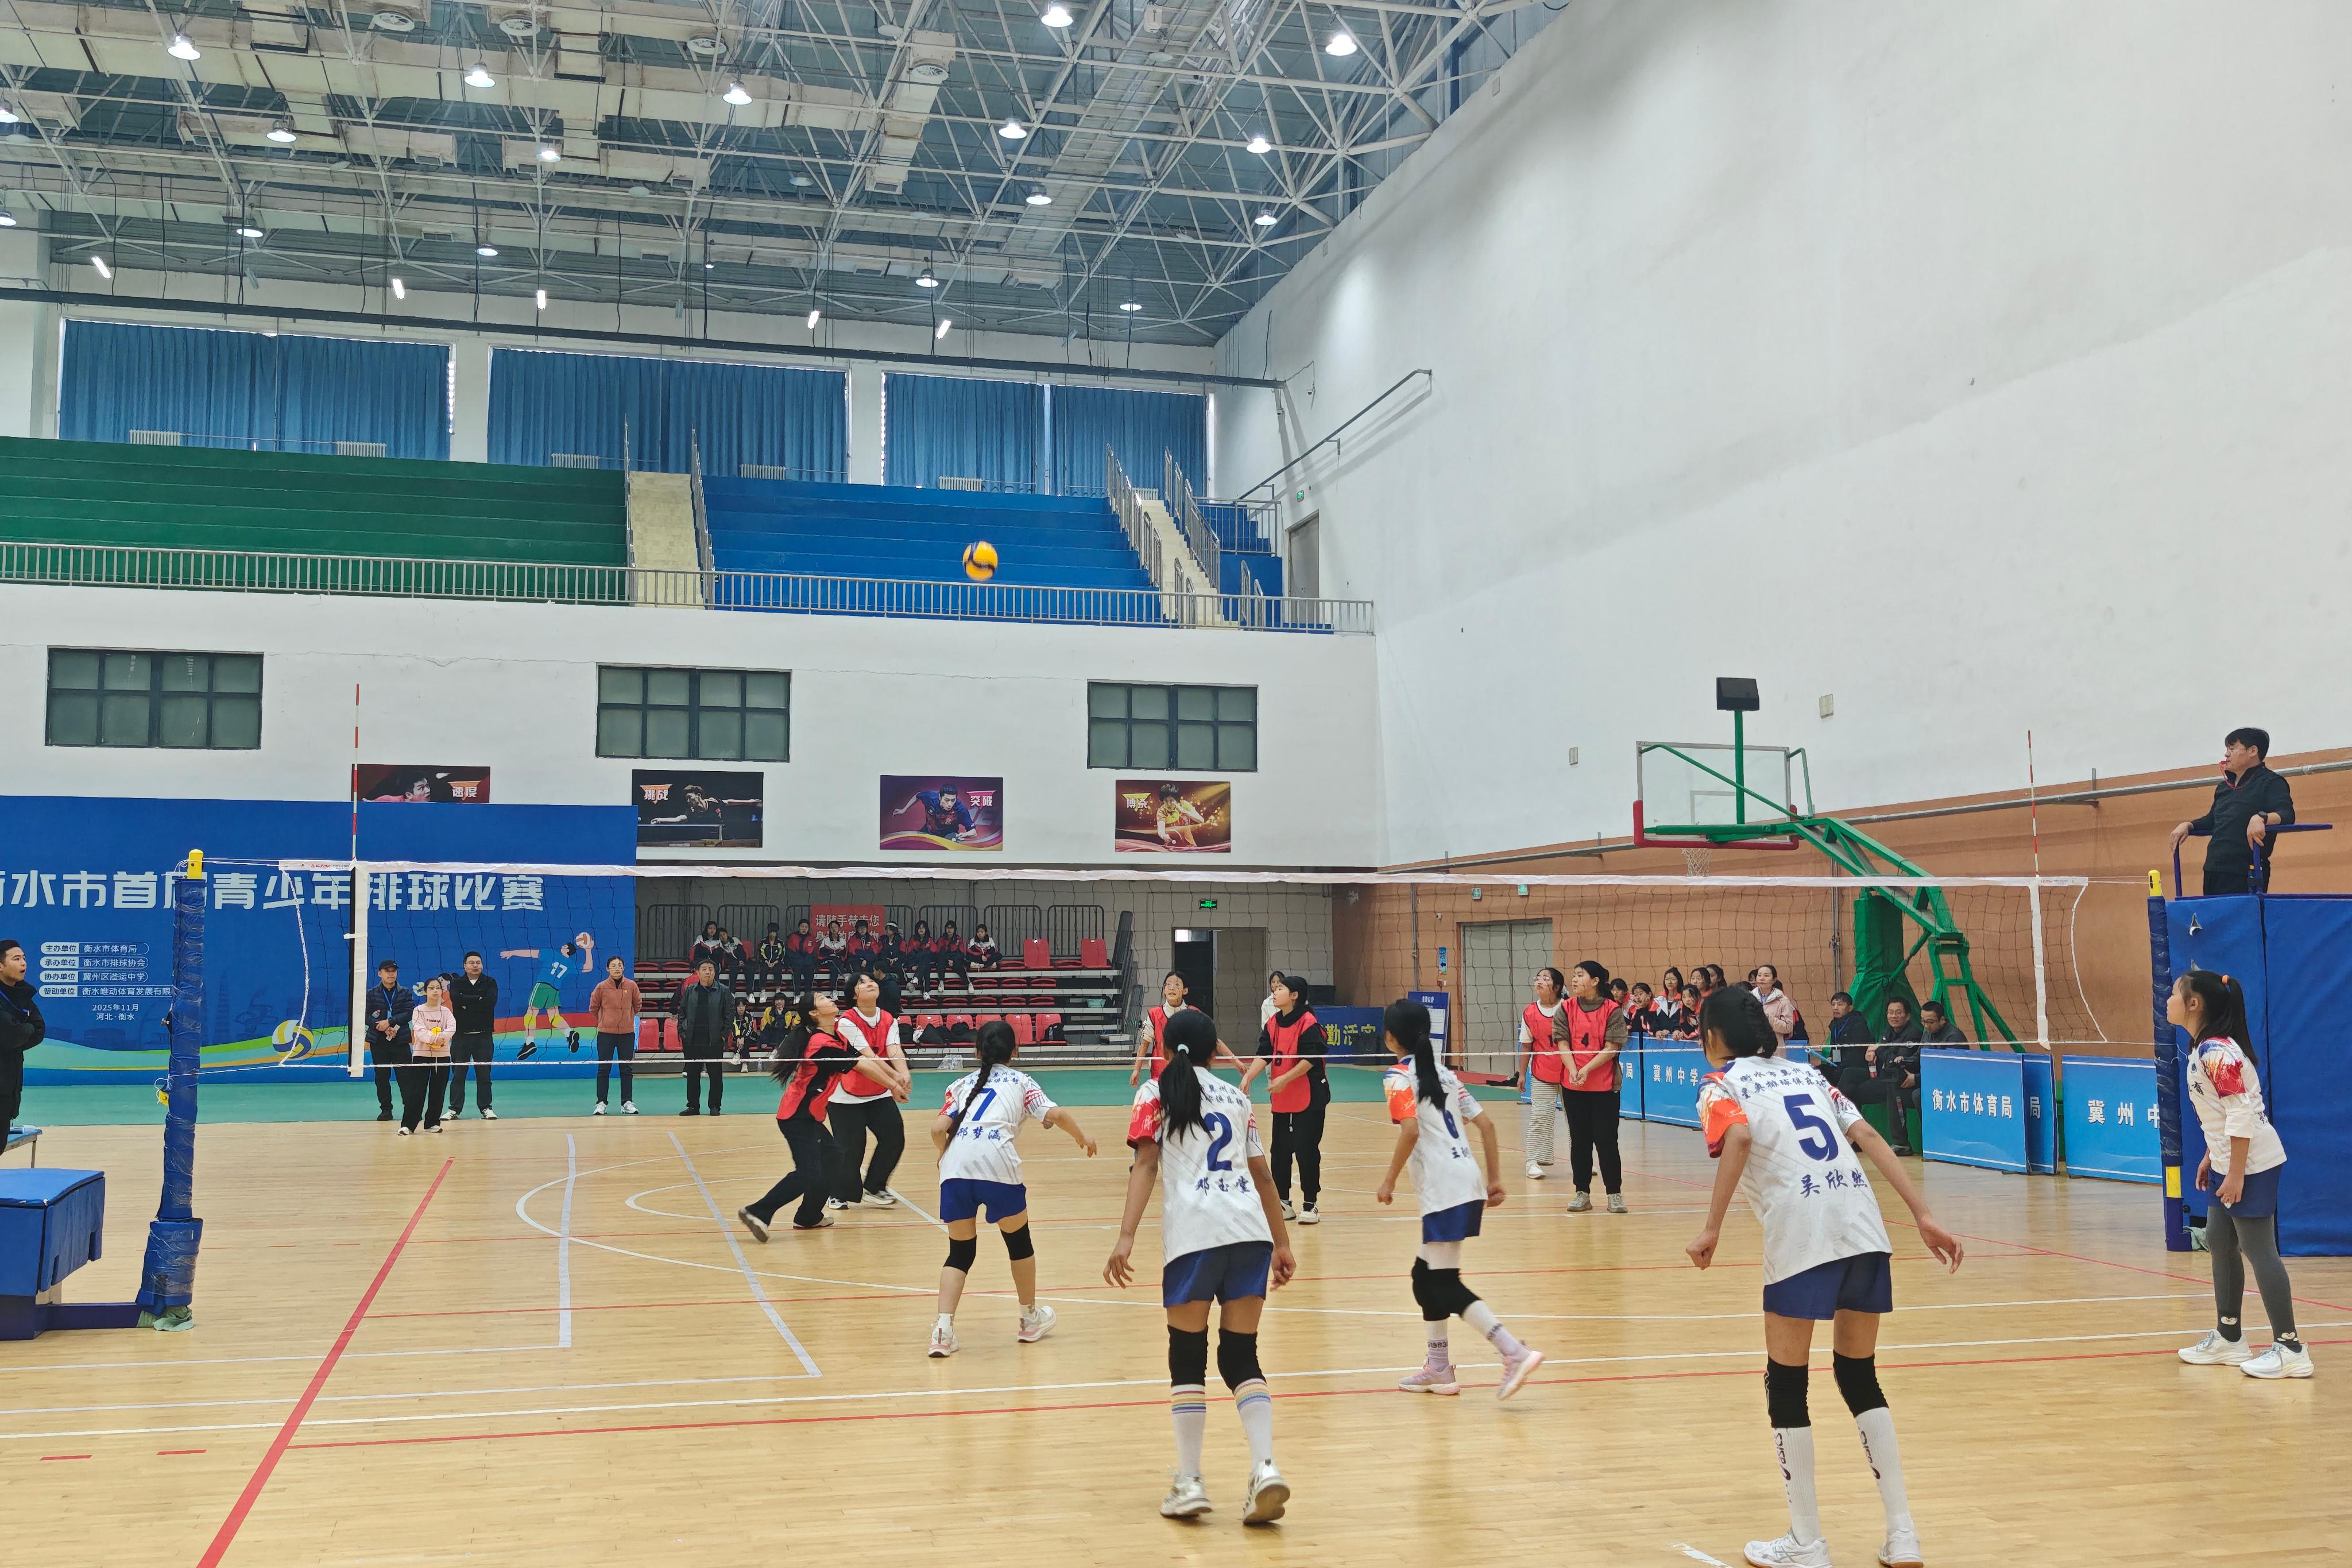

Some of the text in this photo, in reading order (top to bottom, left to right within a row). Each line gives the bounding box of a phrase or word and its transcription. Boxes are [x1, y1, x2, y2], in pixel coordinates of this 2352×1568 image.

[452, 786, 477, 797] 速度
[644, 789, 668, 800] 挑战
[970, 795, 993, 807] 突破
[0, 870, 544, 911] 水市首青少年排球比赛
[84, 944, 137, 953] 衡水市体育局
[83, 958, 145, 967] 衡水市排球协会
[550, 962, 568, 979] 17
[92, 1004, 139, 1012] 2025年11月
[96, 1012, 135, 1021] 河北·衡水
[1581, 1032, 1589, 1048] 4
[1653, 1064, 1698, 1086] 冀州中学
[971, 1087, 997, 1121] 7
[1932, 1089, 2012, 1119] 衡水市体育局
[2029, 1096, 2040, 1119] 局
[2087, 1099, 2160, 1129] 冀州中
[1783, 1093, 1839, 1162] 5
[1204, 1112, 1233, 1172] 2
[1800, 1167, 1868, 1198] 吴欣然
